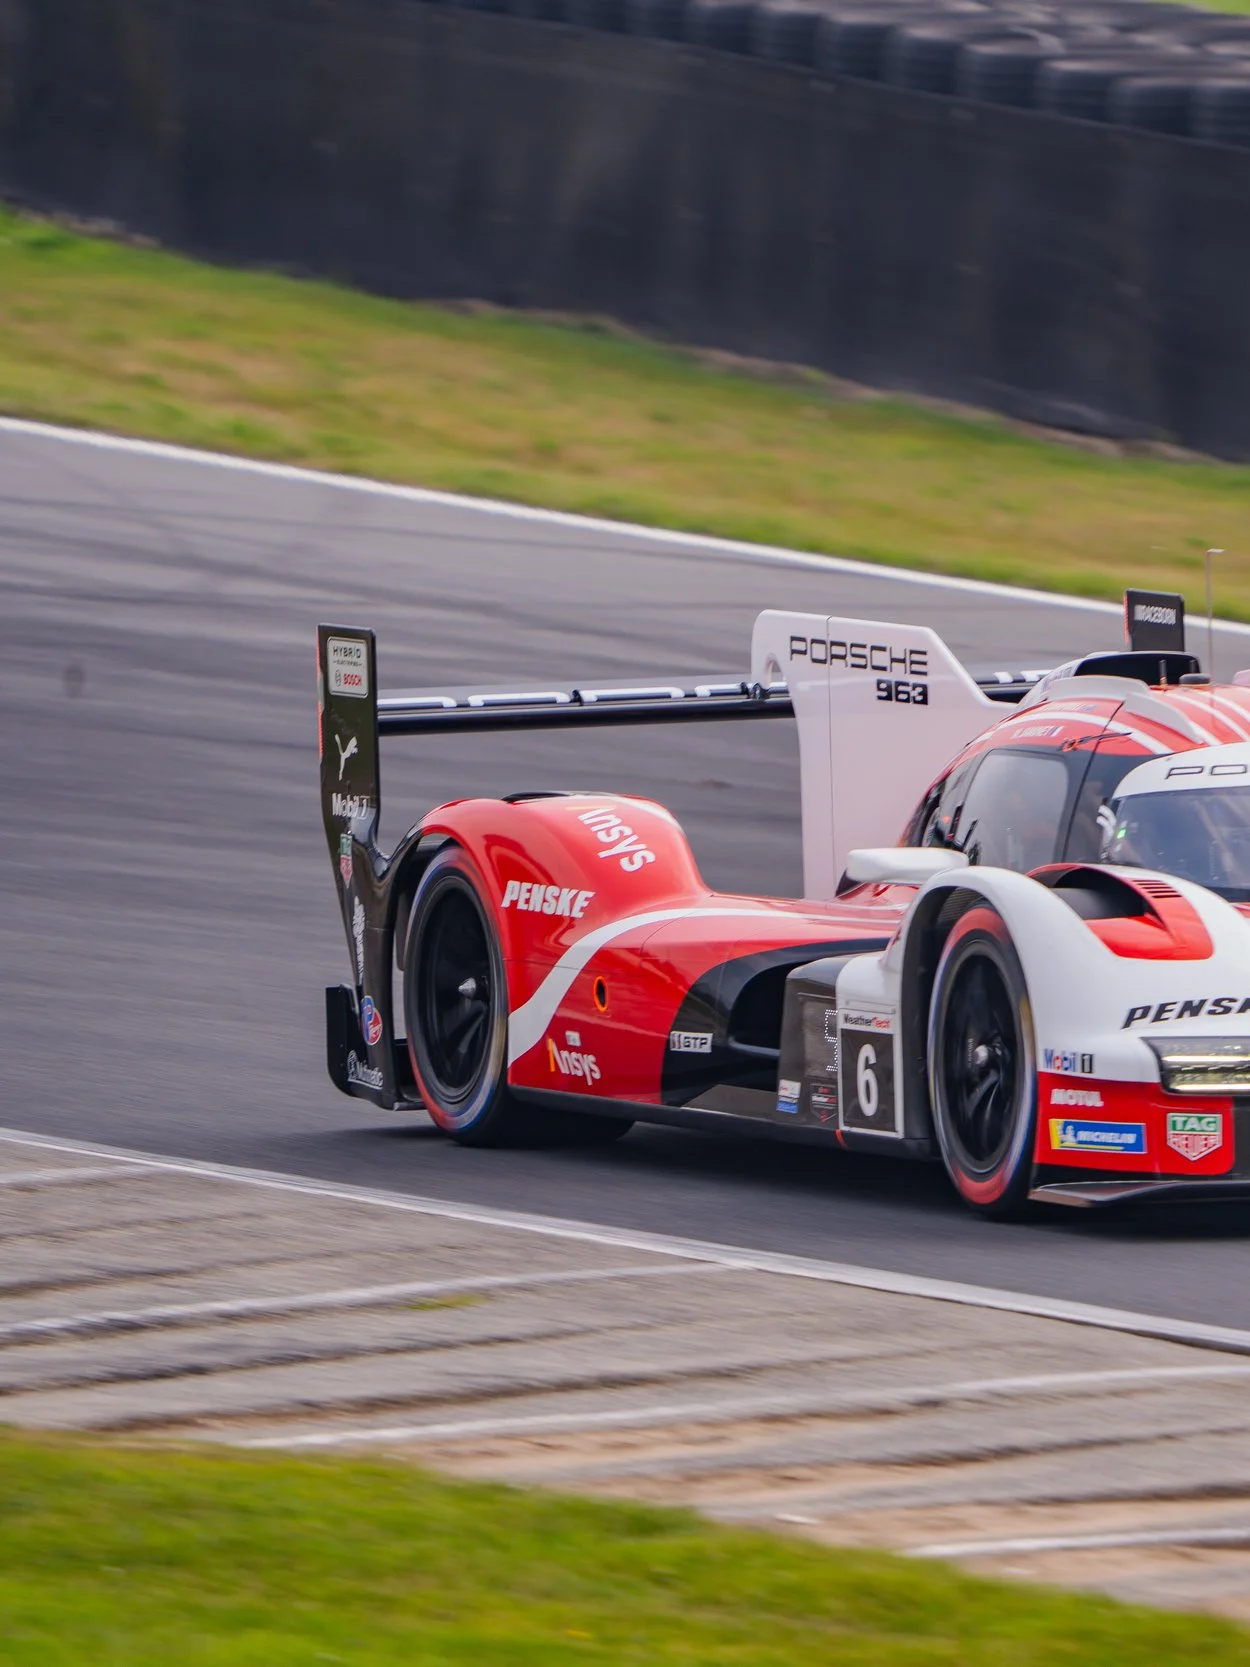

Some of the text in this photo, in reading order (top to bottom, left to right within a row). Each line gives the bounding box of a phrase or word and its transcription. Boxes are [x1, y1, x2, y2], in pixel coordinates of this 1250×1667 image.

[333, 646, 361, 659] HYBRID
[790, 635, 928, 676] PORSCHE
[343, 673, 362, 686] BOSCH
[876, 678, 928, 705] 963
[565, 805, 656, 872] Ansys
[501, 880, 595, 918] PENSKE
[683, 1036, 707, 1050] GTP
[547, 1038, 601, 1085] Ansys
[1043, 1048, 1093, 1074] Mobil 1
[856, 1043, 879, 1117] 6
[1050, 1088, 1104, 1107] MOTUL
[1172, 1116, 1217, 1131] TAG
[1076, 1130, 1137, 1144] MICHELIN
